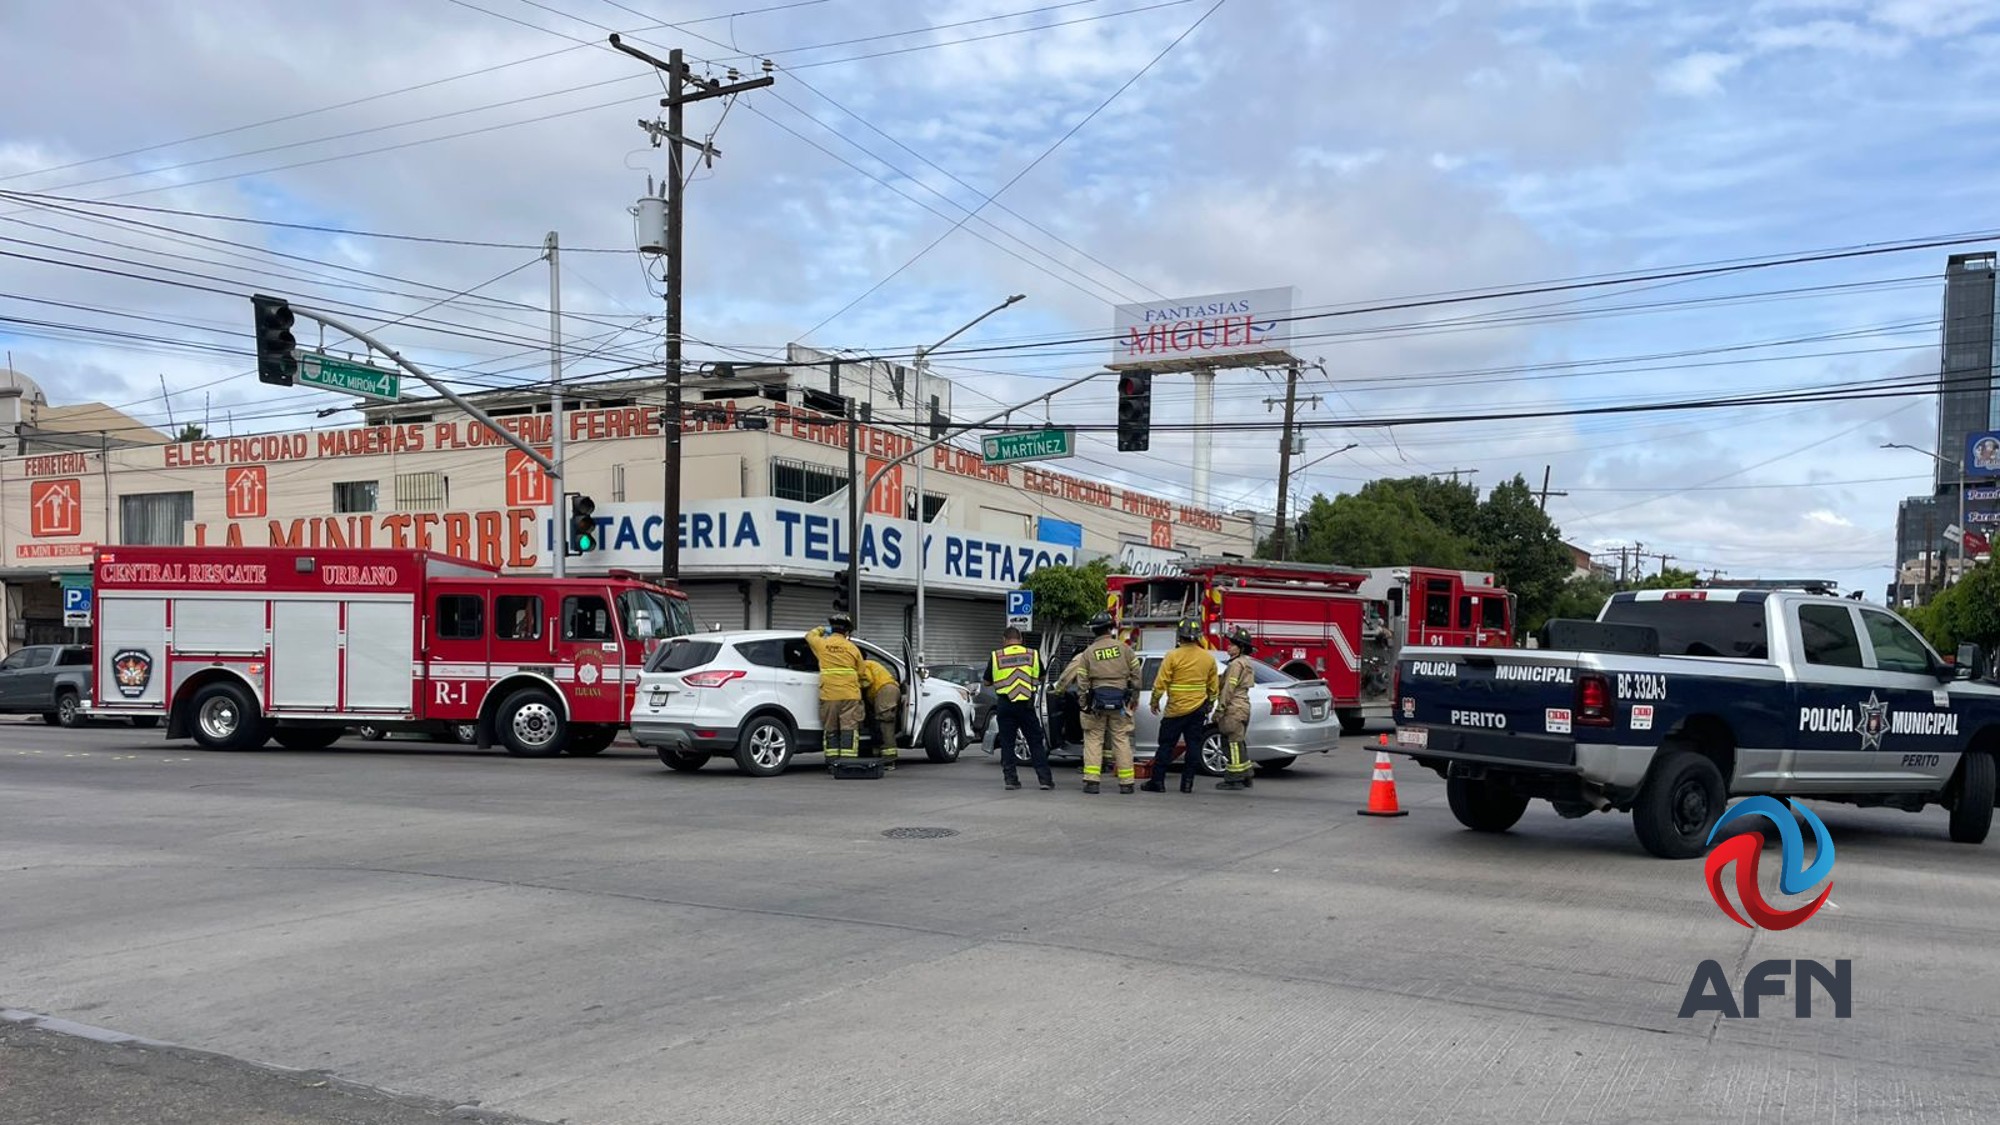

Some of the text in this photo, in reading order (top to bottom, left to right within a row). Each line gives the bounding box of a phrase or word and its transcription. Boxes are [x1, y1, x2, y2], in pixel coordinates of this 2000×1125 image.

[1144, 300, 1249, 322] FANTASIAS
[1128, 315, 1263, 356] MIGUEL
[164, 400, 737, 467] ELECTRICIDAD MADERAS PLOMERIA FERREERIA
[775, 402, 916, 464] FERRETERIA
[1001, 438, 1062, 458] MARTÍNEZ
[25, 453, 88, 476] FERRETERIA
[547, 511, 761, 552] TACERIA
[775, 510, 903, 569] TELAS
[101, 563, 398, 586] CENTRAL RESCATE URBANO
[1095, 646, 1121, 661] FIRE
[1495, 665, 1574, 684] MUNICIPAL
[1617, 673, 1632, 699] BC
[435, 681, 468, 705] R-1
[1451, 710, 1507, 729] PERITO
[1800, 704, 1959, 735] POLICÍA MUNICIPAL
[1901, 754, 1940, 767] PERITO
